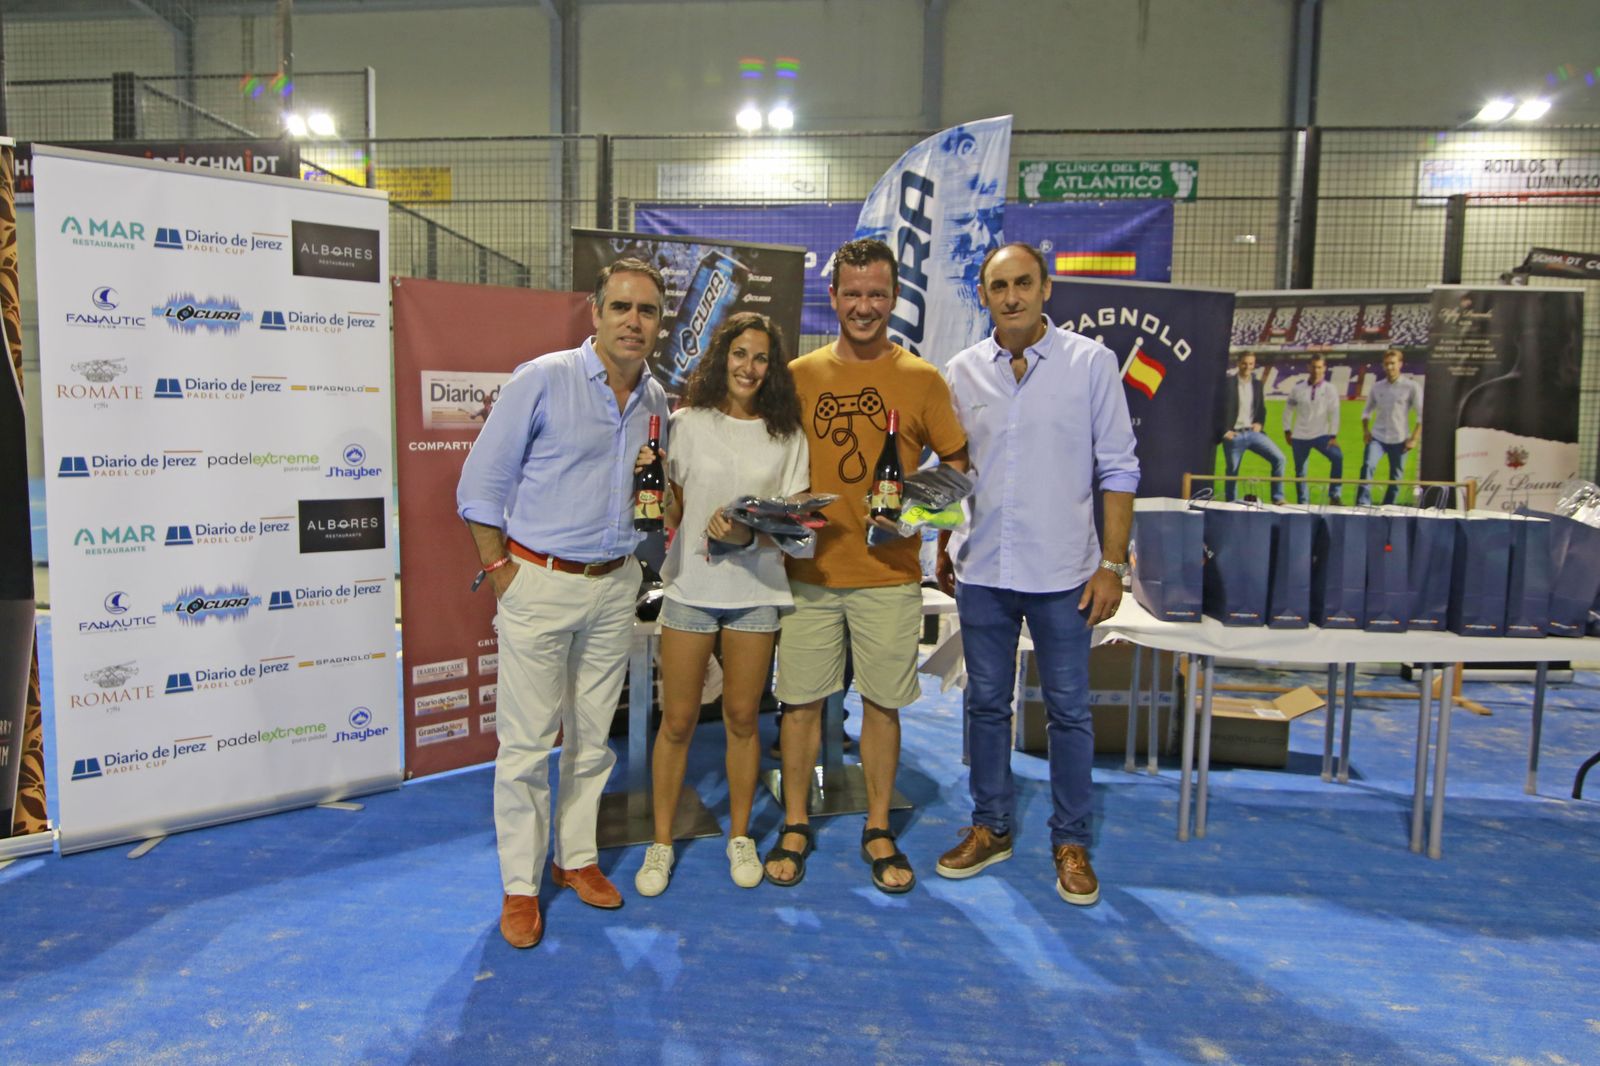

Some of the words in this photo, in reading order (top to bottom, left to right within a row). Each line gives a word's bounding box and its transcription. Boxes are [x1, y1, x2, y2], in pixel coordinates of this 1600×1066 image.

[1111, 163, 1136, 173] DEL
[72, 238, 136, 250] RESTAURANTE
[186, 229, 227, 245] Diario
[231, 233, 247, 247] de
[250, 236, 283, 251] Jerez
[187, 244, 219, 253] PADEL
[224, 247, 245, 256] CUP
[300, 242, 374, 260] ALBORES
[66, 313, 146, 327] FANAUTIC
[165, 304, 241, 321] LOCURA
[288, 311, 327, 324] Diario
[329, 313, 344, 326] de
[347, 315, 376, 329] Jerez
[674, 270, 726, 371] LOCURA
[289, 325, 320, 333] PADEL
[56, 384, 143, 400] ROMATE
[185, 378, 228, 391] Diario
[231, 379, 247, 391] de
[250, 380, 281, 394] Jerez
[430, 382, 485, 402] Diario
[225, 392, 245, 400] CUP
[92, 454, 137, 468] Diario
[141, 454, 159, 467] de
[162, 454, 197, 470] Jerez
[94, 469, 129, 477] PADEL
[195, 522, 236, 536] Diario
[240, 521, 256, 534] de
[259, 521, 290, 536] Jerez
[307, 517, 378, 531] ALBORES
[196, 536, 229, 544] PADEL
[234, 535, 254, 543] CUP
[85, 545, 146, 555] RESTAURANTE
[295, 588, 333, 600] Diario
[335, 585, 351, 597] de
[353, 585, 382, 598] Jerez
[175, 597, 250, 614] LOCURA
[297, 600, 326, 608] PADEL
[330, 598, 349, 606] CUP
[79, 616, 156, 631] FANAUTIC
[315, 654, 370, 665] SPAGNOLO
[195, 667, 236, 682] Diario
[240, 664, 256, 677] de
[259, 663, 290, 678] Jerez
[196, 682, 229, 690] PADEL
[234, 679, 254, 687] CUP
[71, 686, 155, 709] ROMATE
[418, 725, 449, 737] Granada
[104, 750, 149, 766] Diario
[152, 746, 169, 758] de
[173, 742, 206, 759] Jerez
[106, 763, 140, 775] PADEL
[146, 760, 167, 769] CUP
